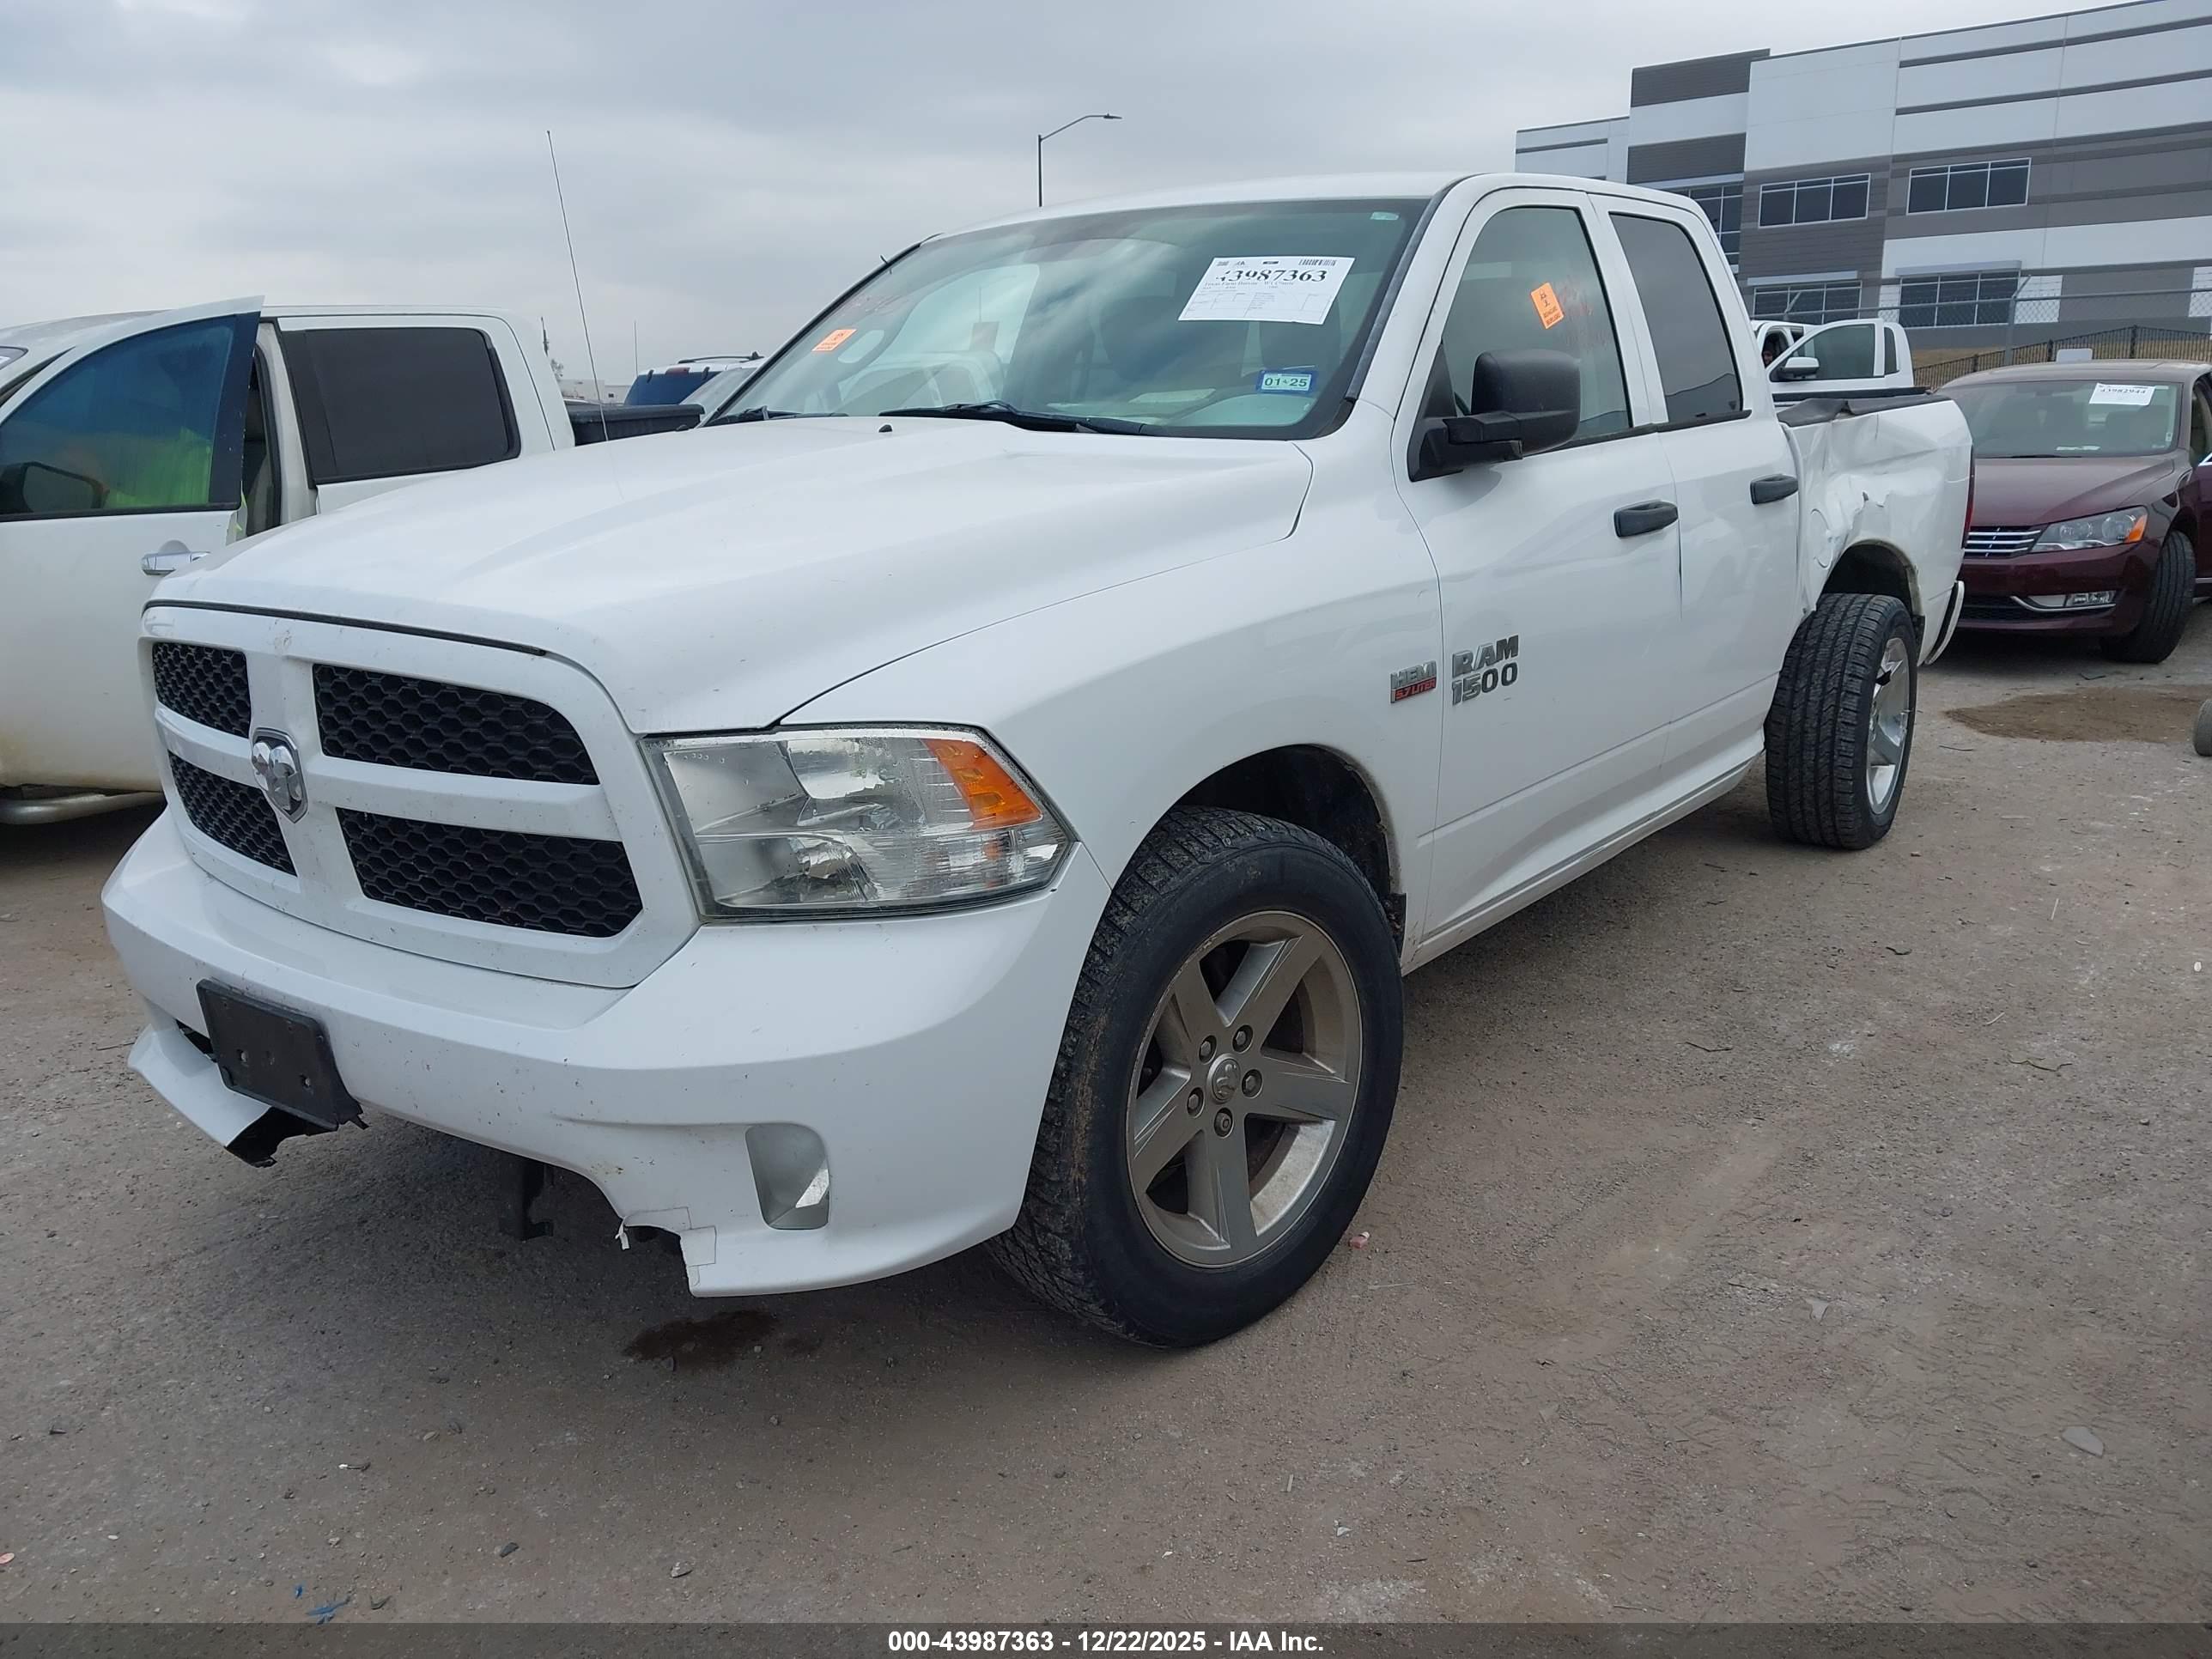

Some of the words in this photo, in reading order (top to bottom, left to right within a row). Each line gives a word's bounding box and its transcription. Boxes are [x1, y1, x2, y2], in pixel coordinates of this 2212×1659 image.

[1390, 660, 1437, 689] HEMI
[1452, 635, 1519, 678] RAM
[1412, 678, 1436, 696] LITER
[1452, 662, 1518, 706] 1500
